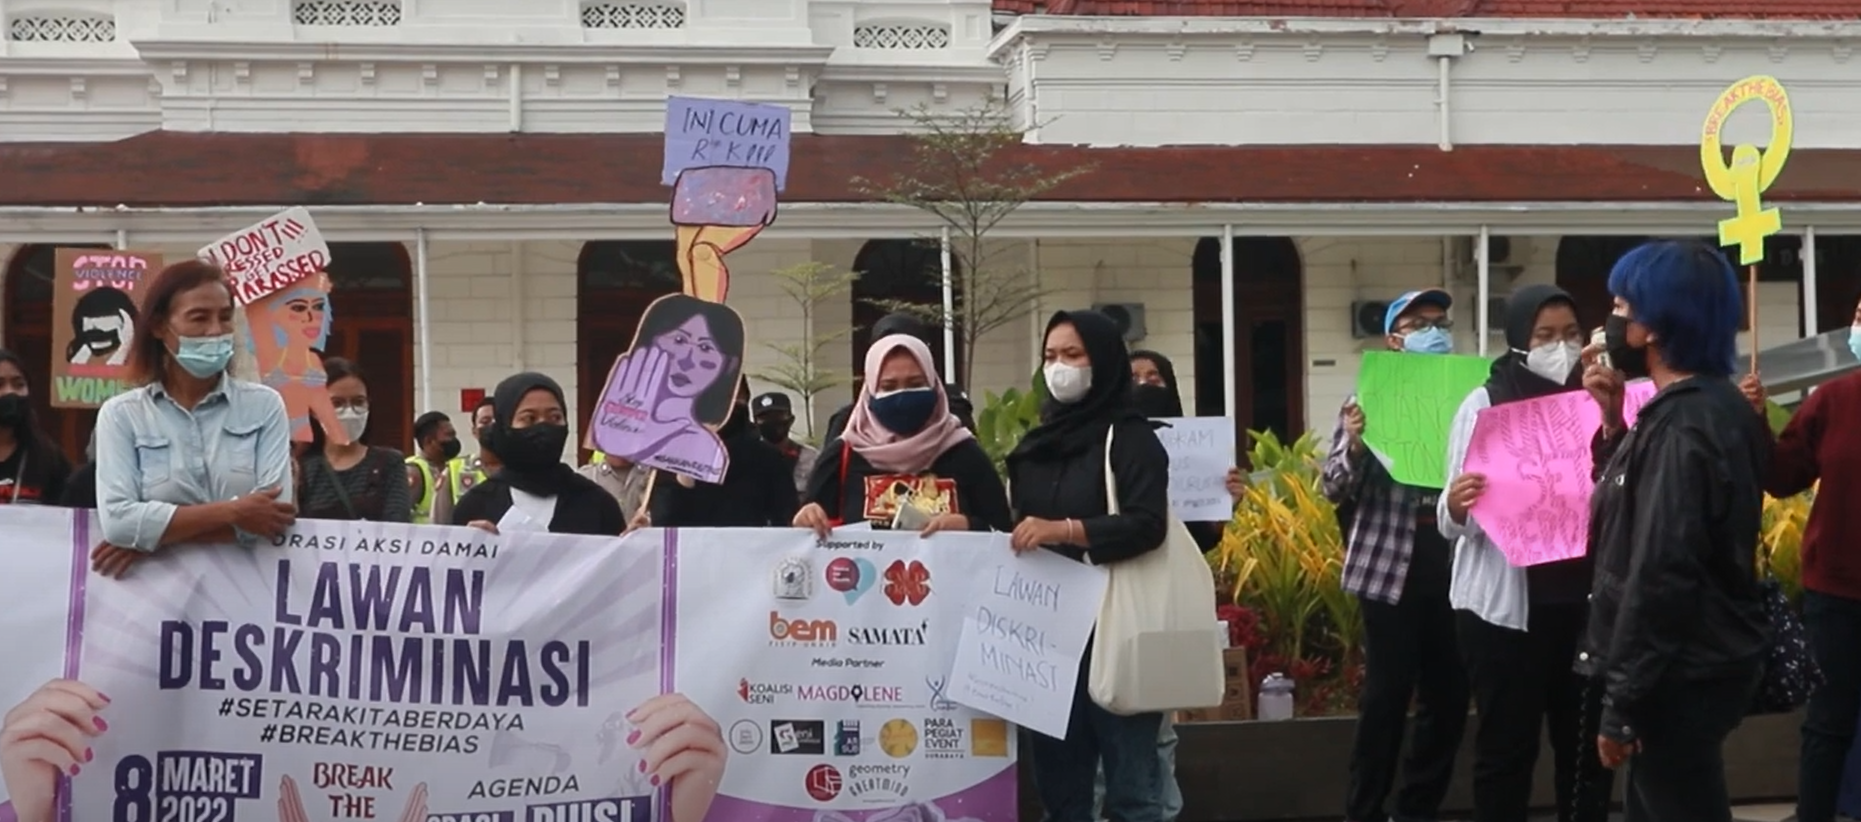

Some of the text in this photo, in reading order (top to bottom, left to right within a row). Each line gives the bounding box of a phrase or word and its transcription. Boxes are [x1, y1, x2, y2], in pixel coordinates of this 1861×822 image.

[683, 107, 782, 140] INI CUMA
[73, 255, 147, 290] STOP
[75, 268, 143, 281] VIOLENCE
[272, 533, 498, 559] ORASI AKSI DAMAI
[815, 539, 884, 551] Supported by
[275, 559, 485, 635] LAWAN
[993, 564, 1060, 612] LAWAN
[770, 611, 837, 641] bem
[848, 626, 926, 646] SAMATA
[159, 620, 591, 707] DESKRIMINASI
[811, 657, 885, 669] Media Partner
[981, 642, 1058, 692] MINASI
[749, 694, 774, 704] SENI
[750, 683, 793, 695] KOALISI
[218, 698, 524, 731] #SETARAKITABERDAYA
[924, 718, 954, 728] PARA
[260, 723, 479, 753] #BREAKTHEBIAS
[924, 728, 964, 739] PEGIAT
[924, 739, 961, 749] EVENT
[162, 756, 255, 794] MARET
[313, 762, 393, 790] BREAK
[848, 763, 911, 779] geometry
[113, 754, 153, 822] 8
[467, 774, 580, 800] AGENDA
[161, 795, 228, 822] 2022
[329, 794, 375, 818] THE
